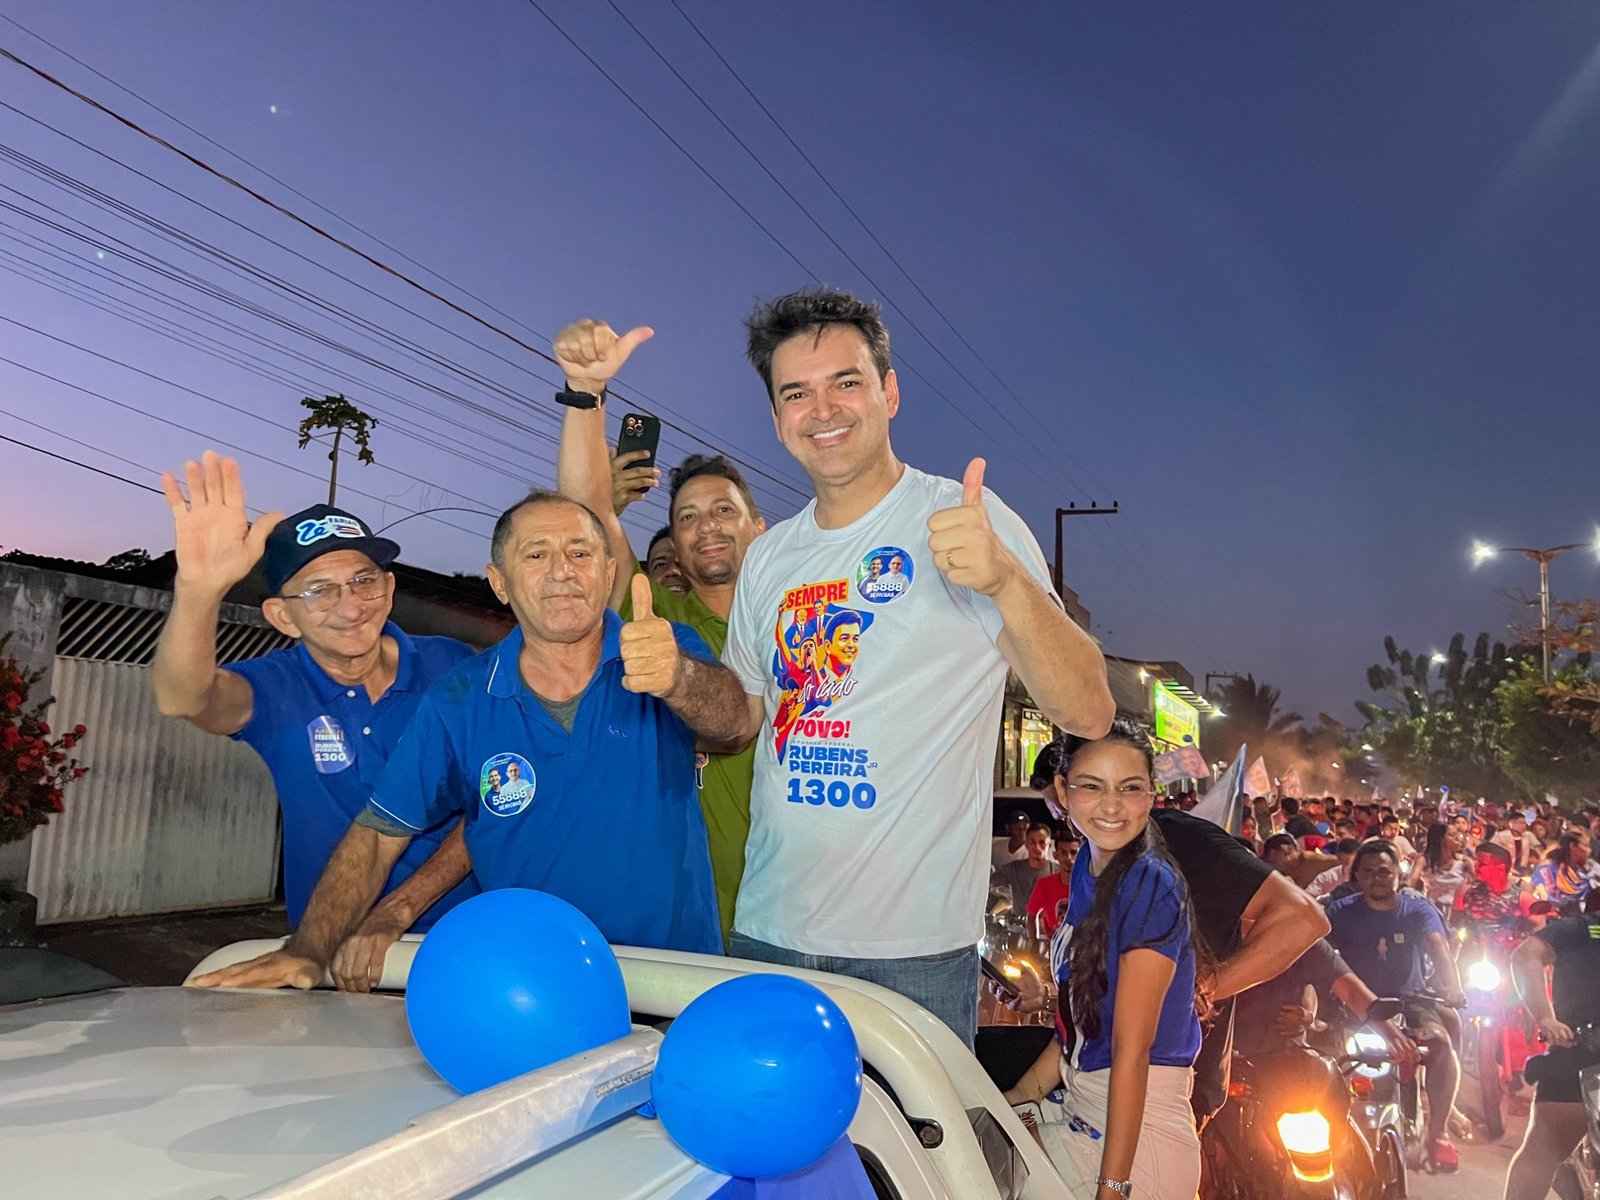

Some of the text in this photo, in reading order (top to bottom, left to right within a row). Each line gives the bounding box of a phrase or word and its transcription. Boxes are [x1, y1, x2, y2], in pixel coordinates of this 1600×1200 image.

[299, 520, 329, 542] Zé
[786, 581, 848, 609] SEMPRE
[815, 670, 859, 699] lado
[808, 710, 825, 718] DO
[793, 718, 851, 739] POVO!
[314, 752, 346, 762] 1300
[789, 745, 869, 764] RUBENS
[789, 760, 867, 778] PEREIRA
[492, 789, 528, 805] 55888
[787, 777, 877, 810] 1300
